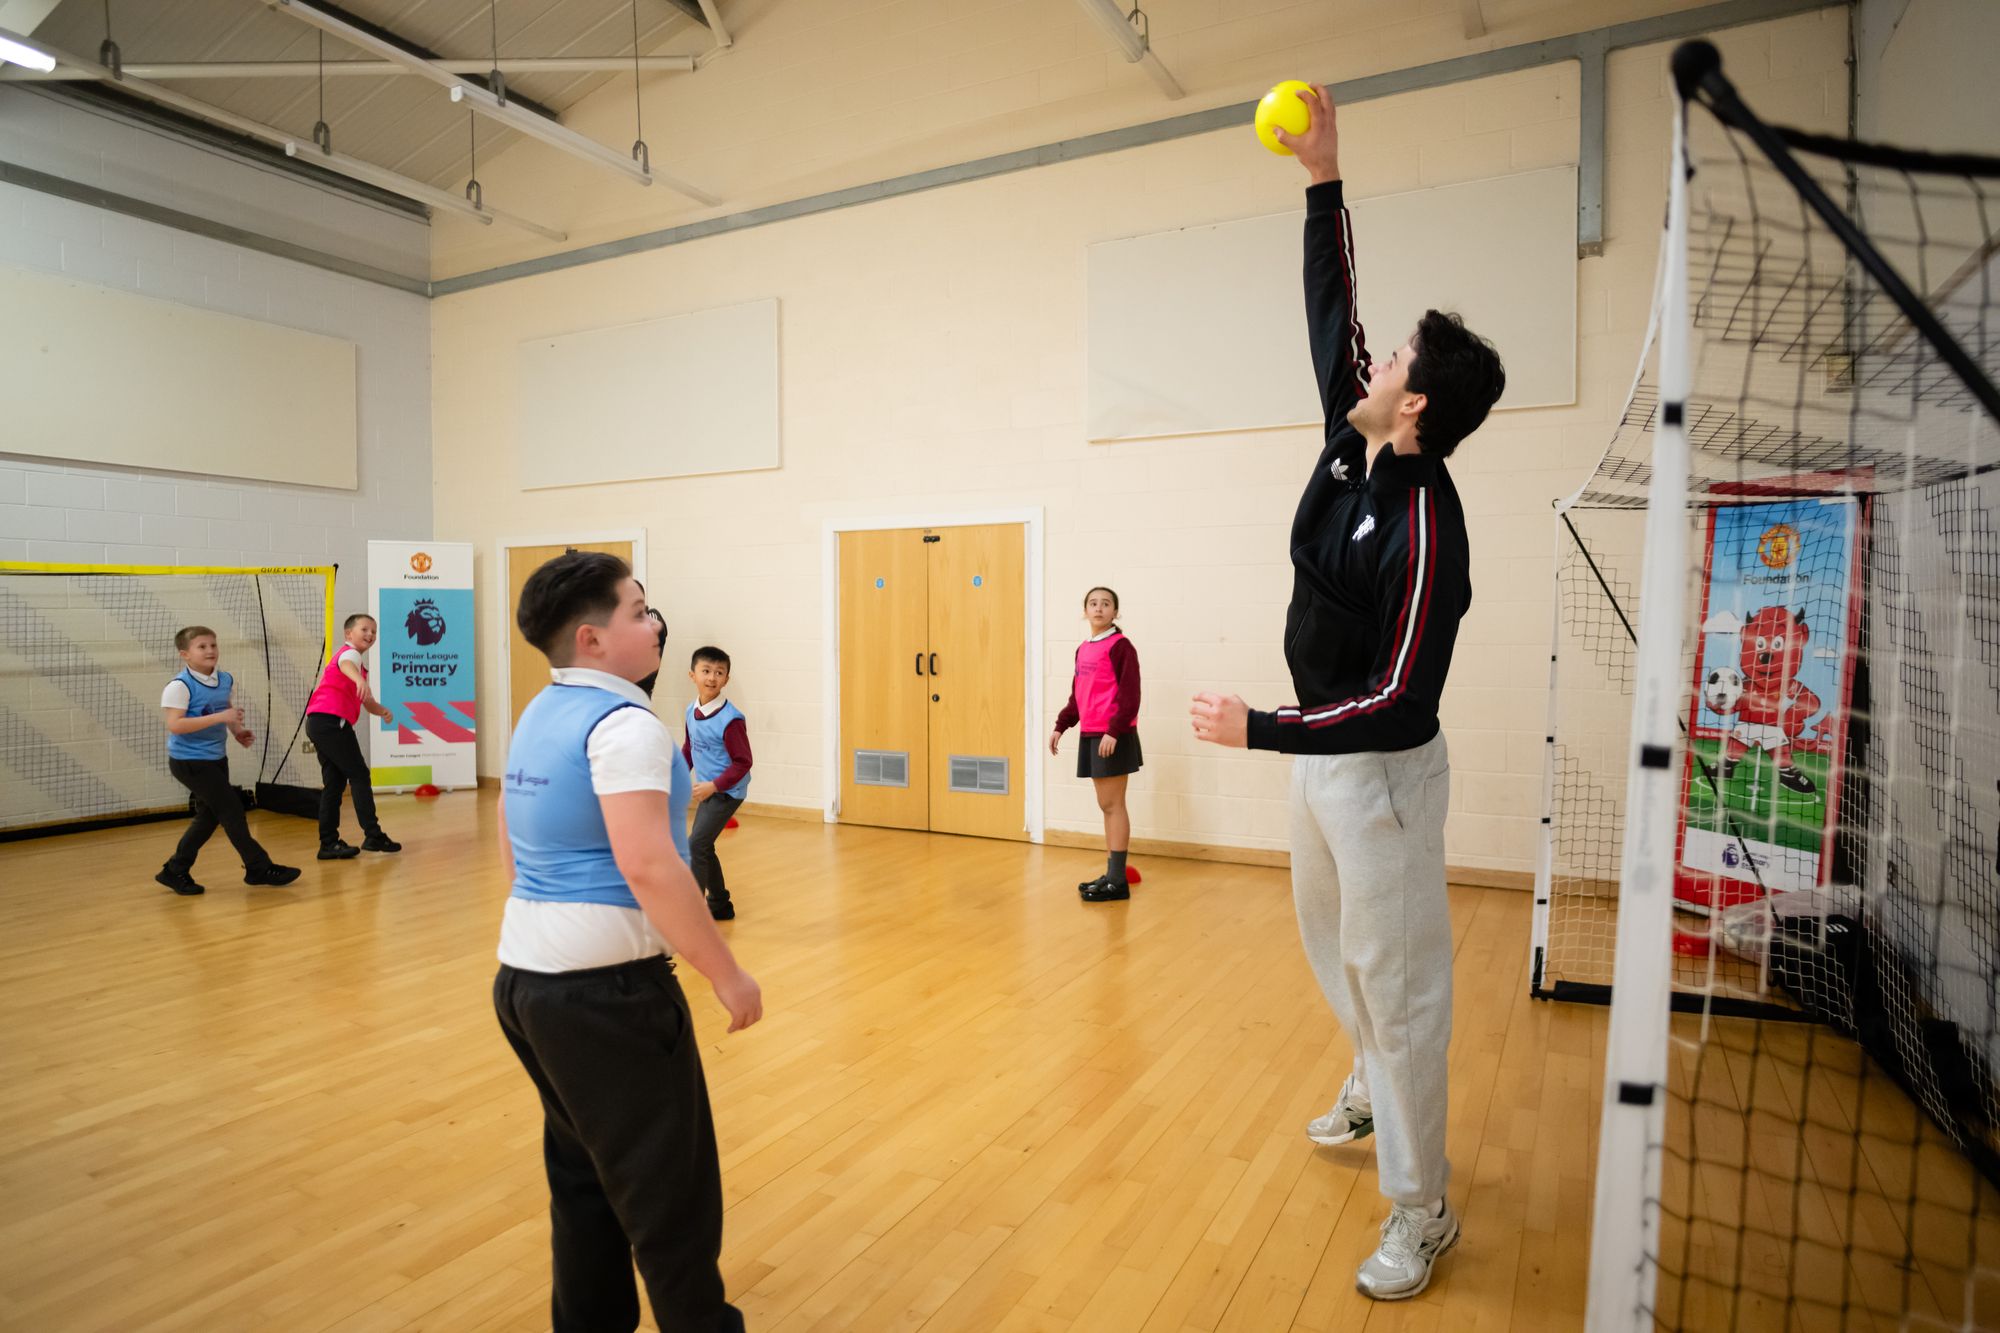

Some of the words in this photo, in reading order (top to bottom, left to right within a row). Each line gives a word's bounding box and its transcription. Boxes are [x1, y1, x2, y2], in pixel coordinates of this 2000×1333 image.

[1743, 572, 1810, 585] Foundaton
[392, 652, 424, 660] Premier
[426, 652, 458, 661] League
[392, 661, 458, 676] Primary
[405, 675, 447, 687] Stars
